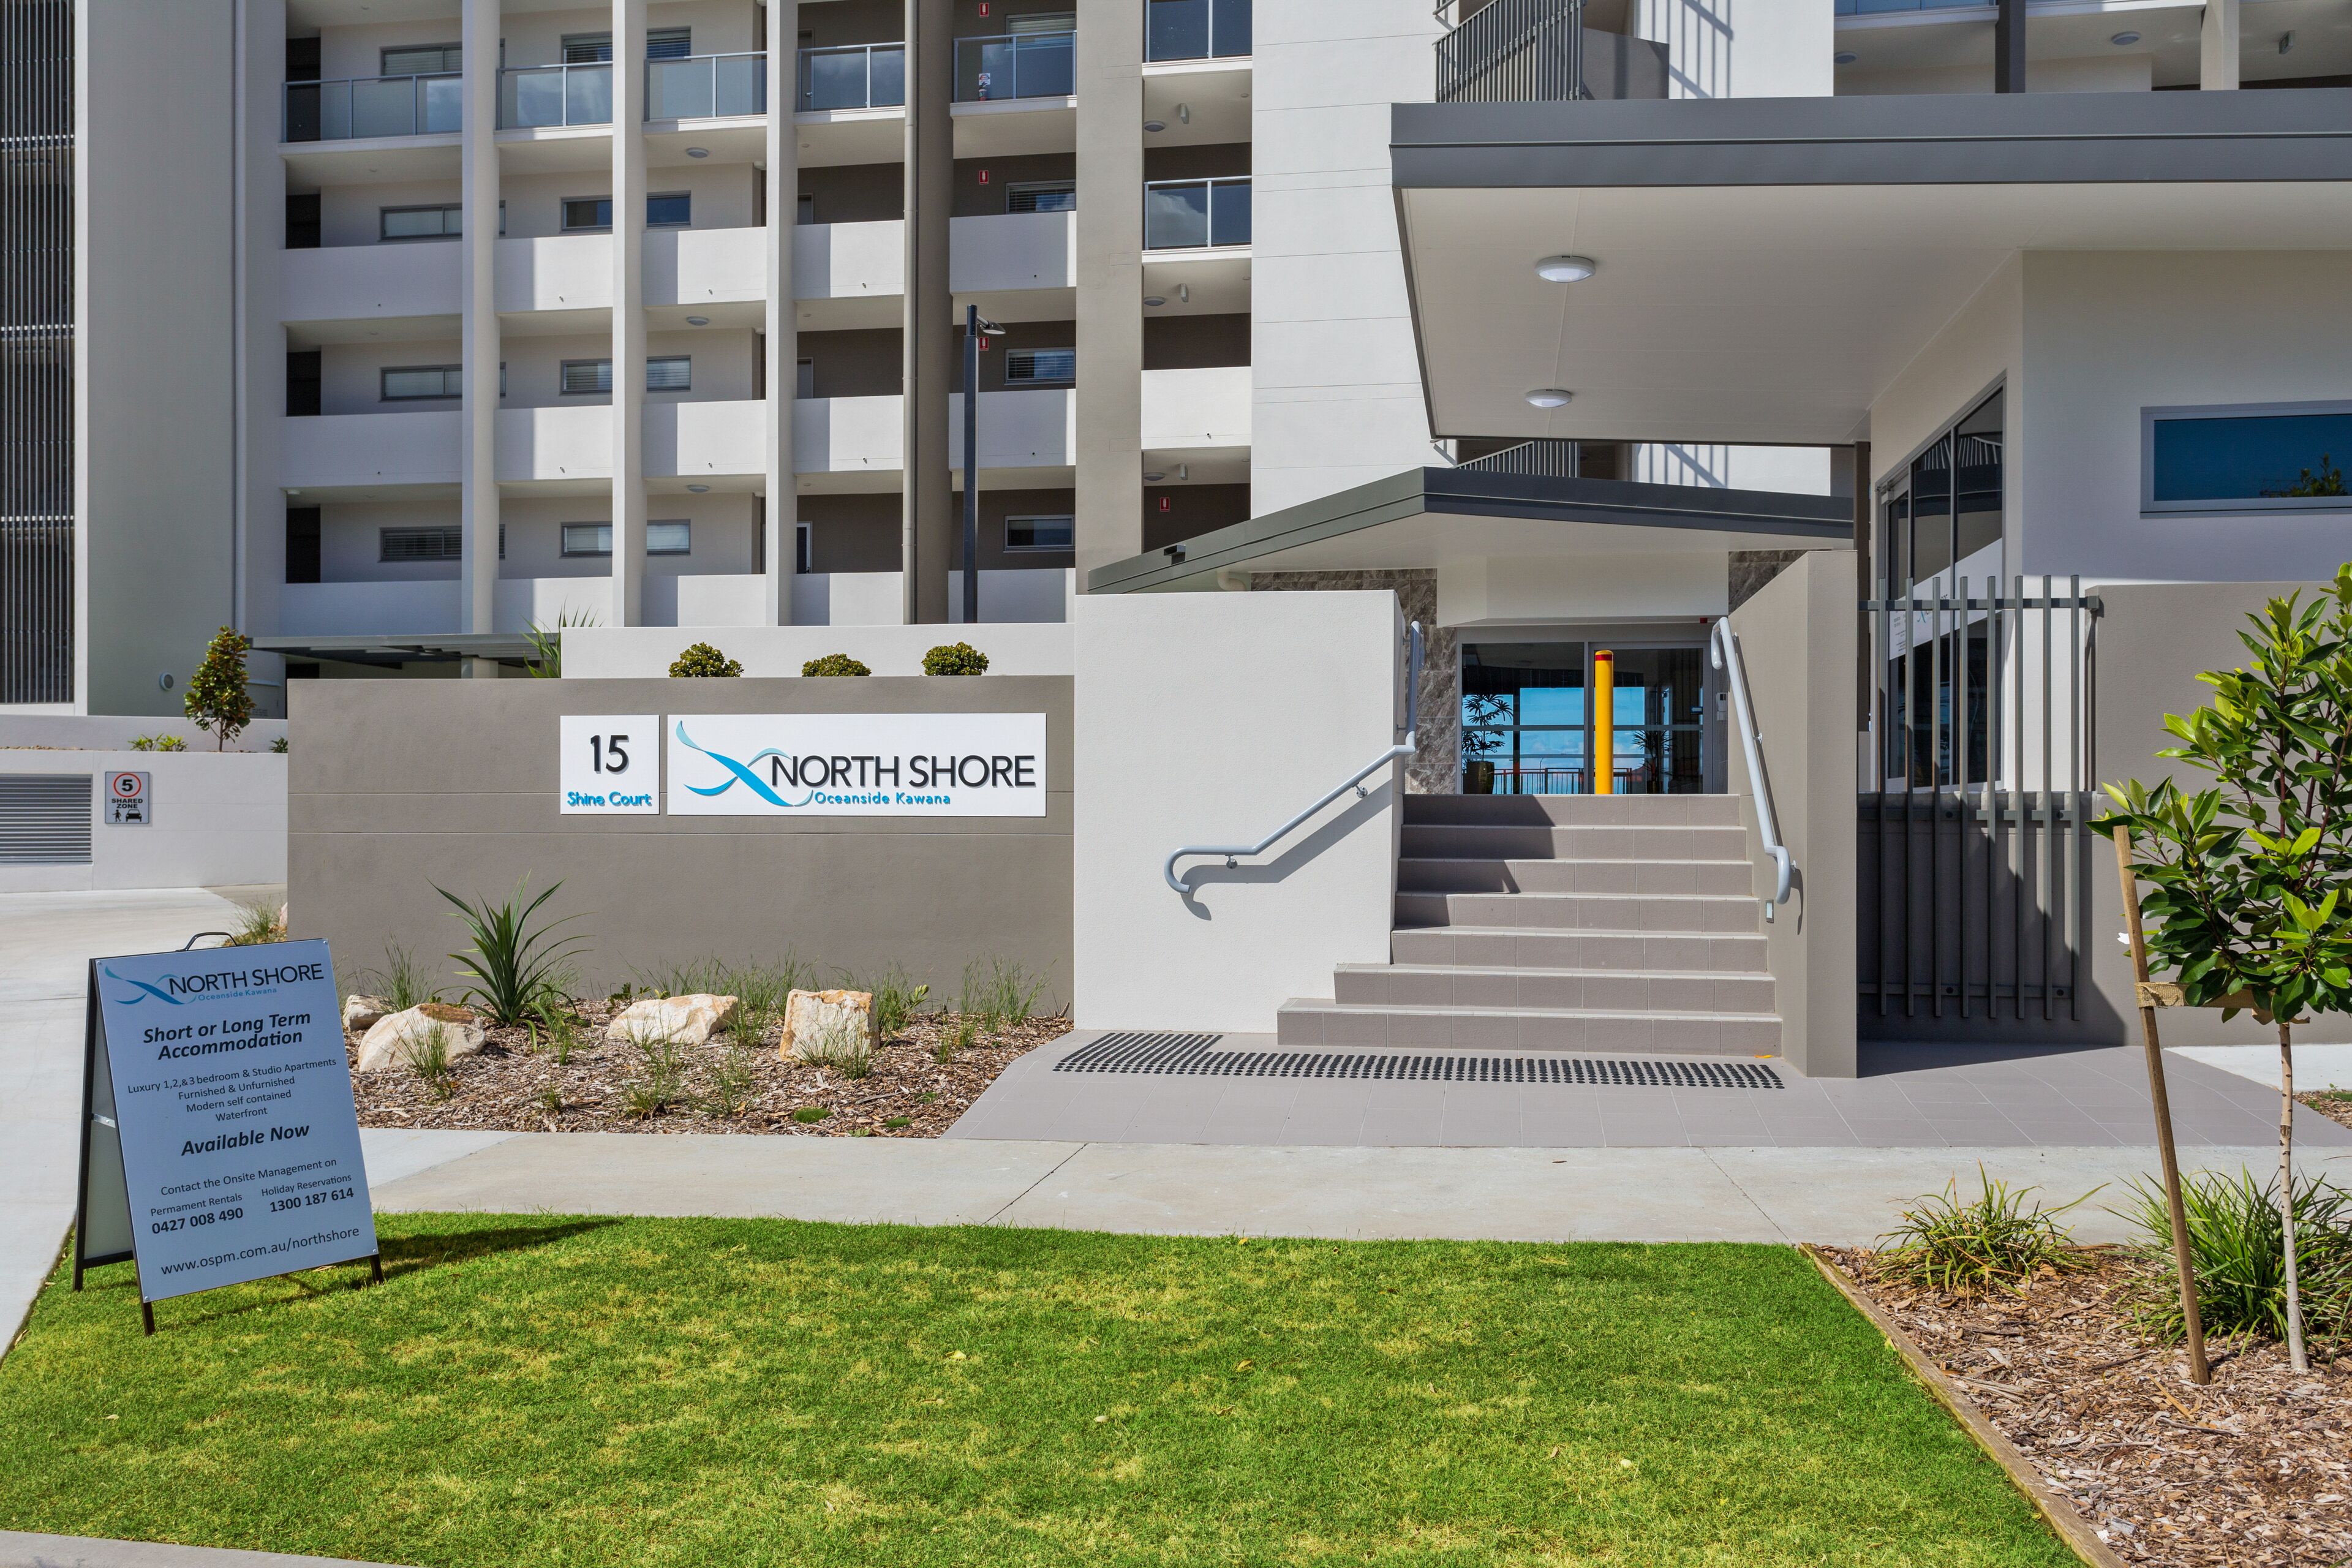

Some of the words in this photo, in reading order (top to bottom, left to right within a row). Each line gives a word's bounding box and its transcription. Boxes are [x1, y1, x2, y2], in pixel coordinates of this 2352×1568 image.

[590, 735, 628, 773] 15
[772, 755, 899, 787] NORTH
[908, 755, 1036, 787] SHORE
[121, 779, 134, 791] 5
[567, 791, 605, 805] Shine
[609, 791, 652, 805] Court
[814, 791, 890, 804] Oceanside
[895, 792, 951, 804] Kawana
[169, 971, 248, 995] NORTH
[252, 963, 324, 987] SHORE
[198, 990, 243, 1001] Oceanside
[143, 1025, 193, 1044] Short
[198, 1024, 217, 1037] or
[222, 1019, 263, 1034] Long
[268, 1013, 311, 1028] Term
[157, 1030, 303, 1061] Accommodation
[127, 1083, 161, 1093] Luxury
[196, 1072, 240, 1084] bedroom
[243, 1069, 251, 1078] &
[252, 1065, 282, 1077] Studio
[284, 1058, 337, 1073] Apartments
[178, 1085, 225, 1100] Furnished
[228, 1084, 236, 1093] &
[238, 1076, 295, 1091] Unfurnished
[186, 1101, 225, 1113] Modern
[227, 1096, 244, 1107] self
[246, 1089, 292, 1104] contained
[215, 1107, 268, 1121] Waterfront
[181, 1129, 265, 1156] Available
[270, 1125, 310, 1142] Now
[160, 1182, 202, 1196] Contact
[203, 1178, 221, 1188] the
[223, 1172, 255, 1185] Onsite
[258, 1161, 323, 1179] Management
[261, 1185, 295, 1197] Holiday
[297, 1175, 352, 1190] Reservations
[150, 1200, 207, 1217] Permament
[208, 1193, 243, 1207] Rentals
[270, 1197, 301, 1213] 1300
[304, 1192, 327, 1206] 187
[331, 1187, 355, 1201] 614
[151, 1218, 186, 1234] 0427
[189, 1212, 216, 1227] 008
[218, 1207, 244, 1221] 490
[160, 1228, 360, 1275] www.ospm.com.au/northshore
